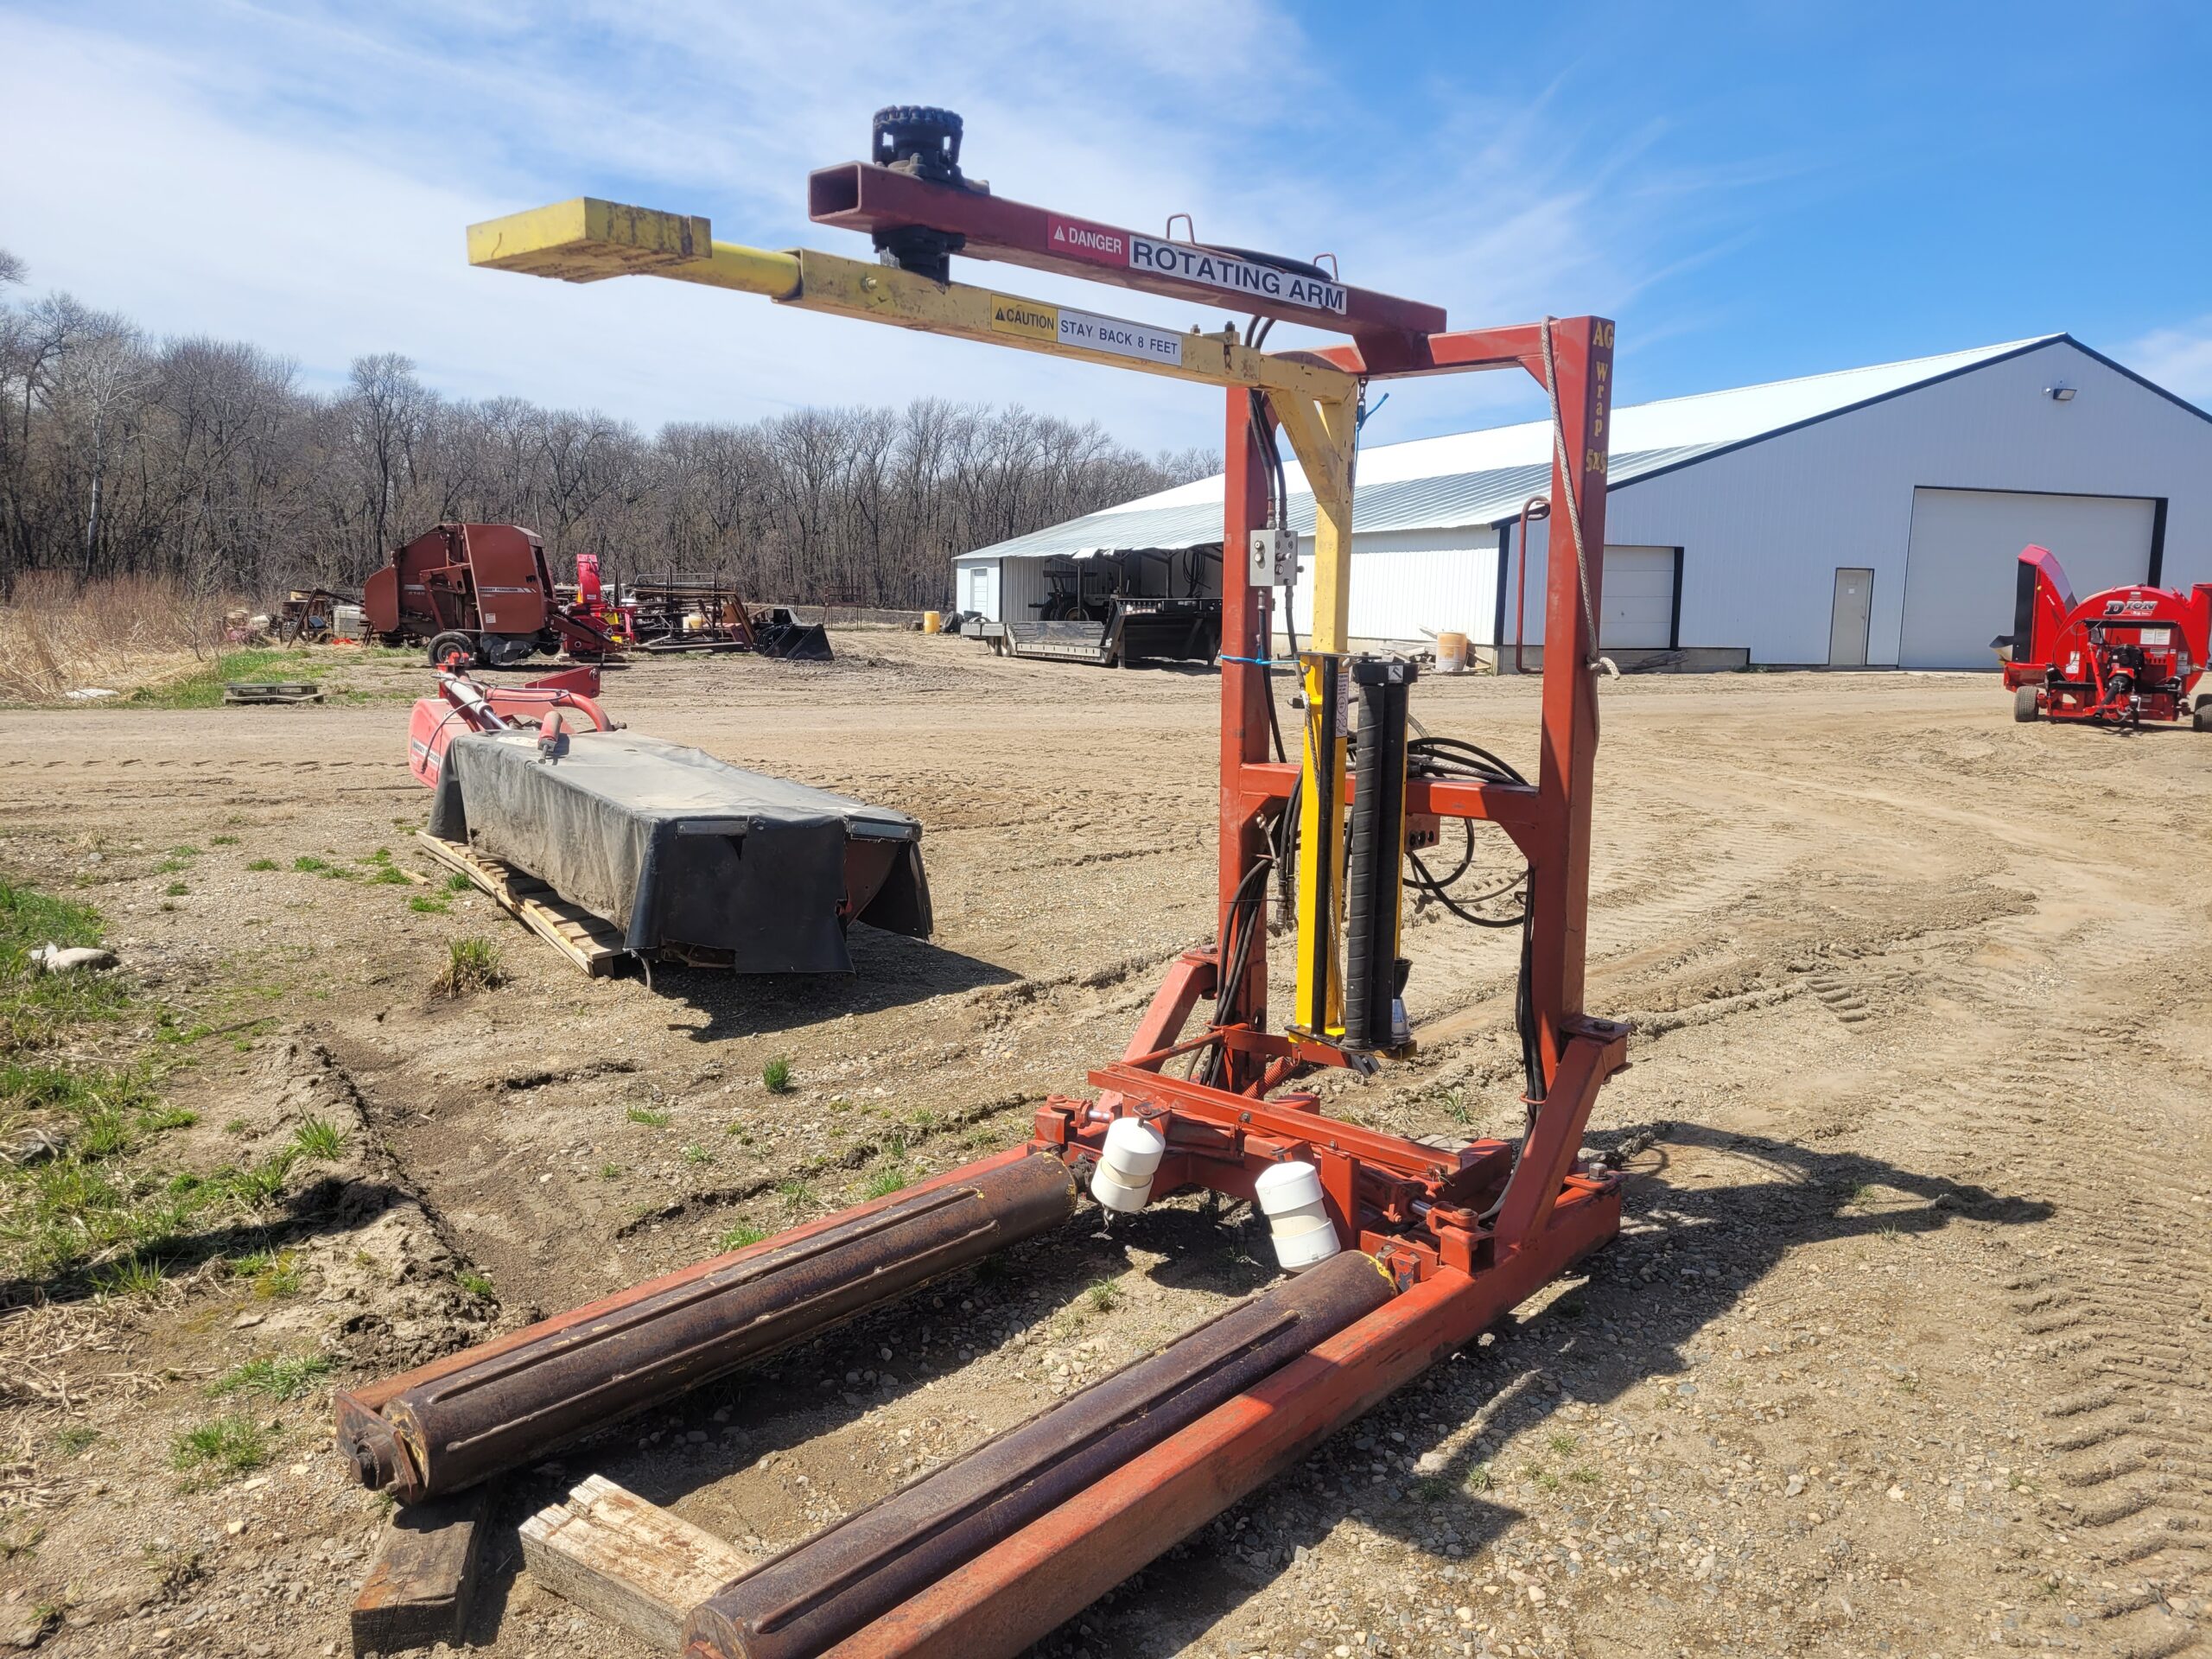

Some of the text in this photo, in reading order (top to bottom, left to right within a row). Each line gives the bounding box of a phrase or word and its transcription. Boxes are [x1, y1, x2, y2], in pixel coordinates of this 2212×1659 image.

[1069, 227, 1122, 254] DANGER
[1133, 241, 1344, 309] ROTATING ARM
[1007, 308, 1055, 330] CAUTION
[1061, 320, 1178, 355] STAY BACK 8 FEET
[1592, 321, 1614, 349] AG
